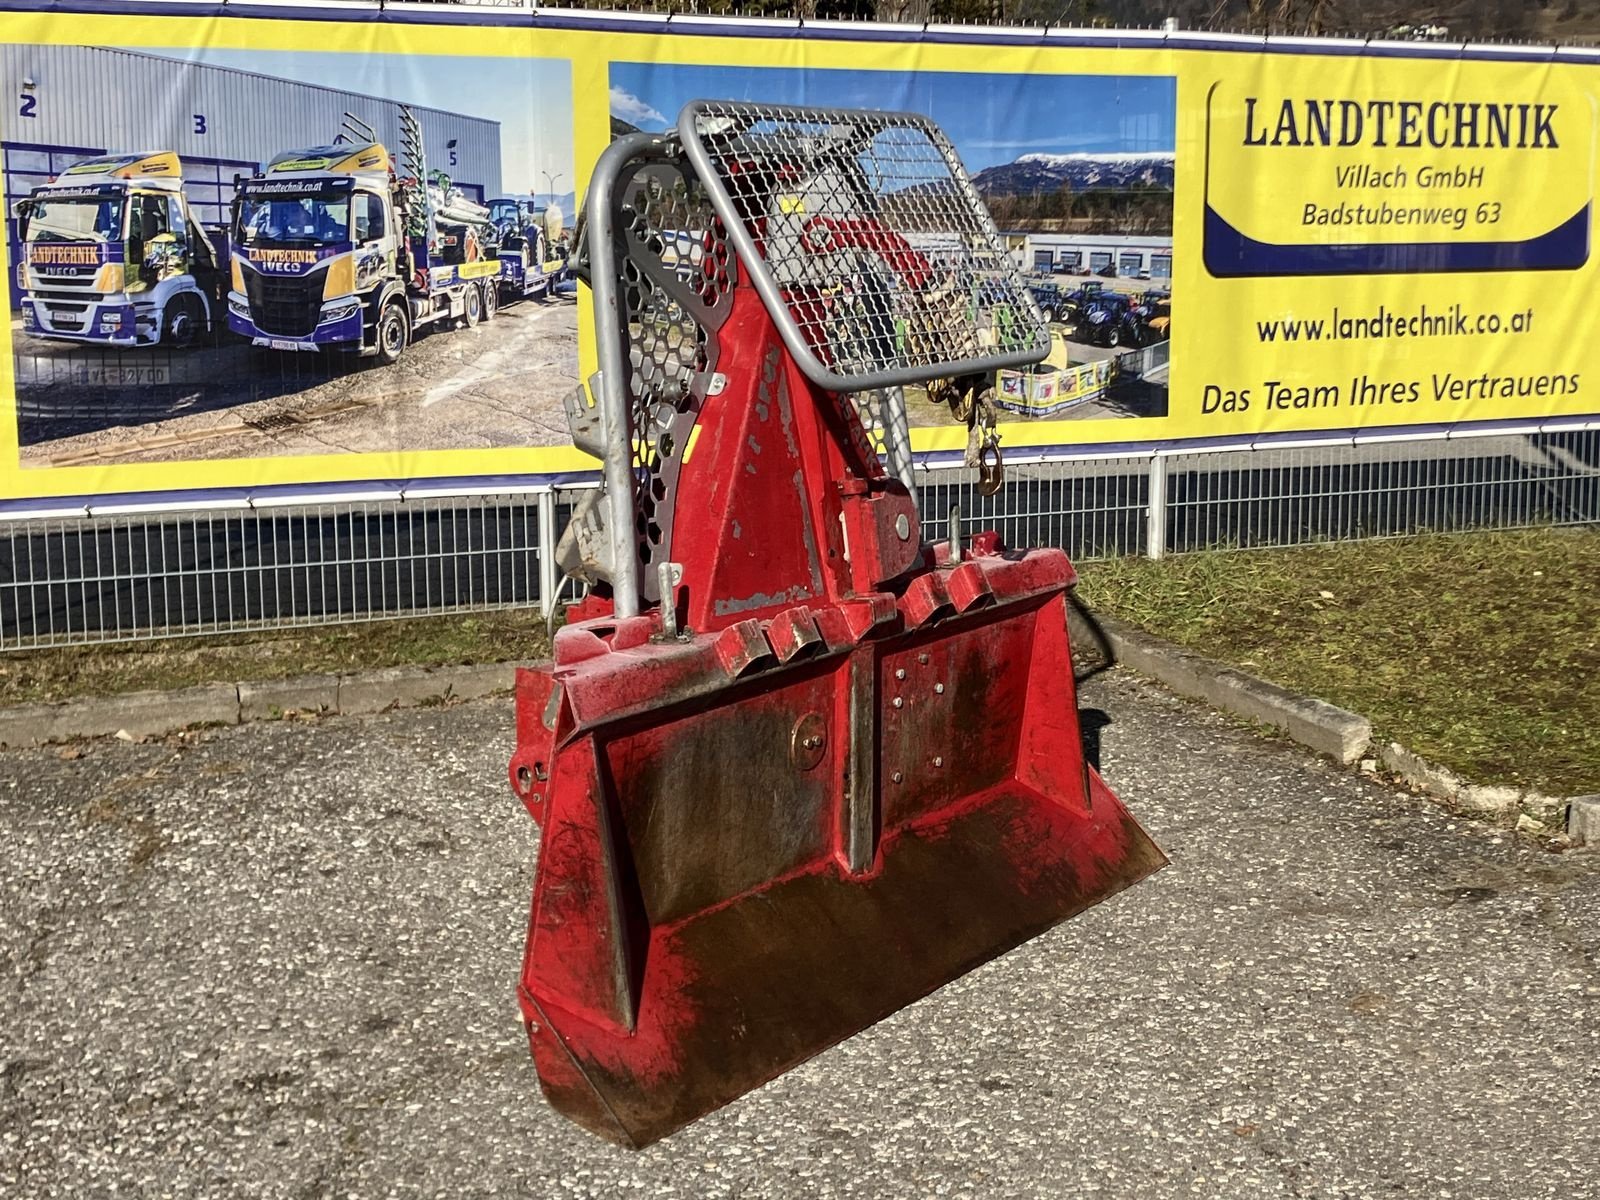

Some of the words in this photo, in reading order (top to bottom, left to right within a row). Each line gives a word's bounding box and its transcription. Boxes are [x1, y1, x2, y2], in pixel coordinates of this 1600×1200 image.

[20, 94, 37, 118] 2
[193, 114, 207, 135] 3
[1243, 98, 1560, 149] LANDTECHNIK
[449, 151, 457, 166] 5
[246, 182, 322, 193] www.landtechnik.co.at
[1335, 164, 1407, 189] Villach
[1416, 165, 1485, 189] GmbH
[1302, 202, 1467, 230] Badstubenweg
[1475, 202, 1502, 225] 63
[249, 249, 318, 263] LANDTECHNIK
[261, 261, 301, 273] IVECO
[46, 267, 77, 277] IVECO
[1258, 304, 1533, 342] www.landtechnik.co.at
[1202, 384, 1250, 415] Das
[1264, 381, 1338, 411] Team
[1350, 376, 1420, 406] Ihres
[1432, 373, 1580, 402] Vertrauens
